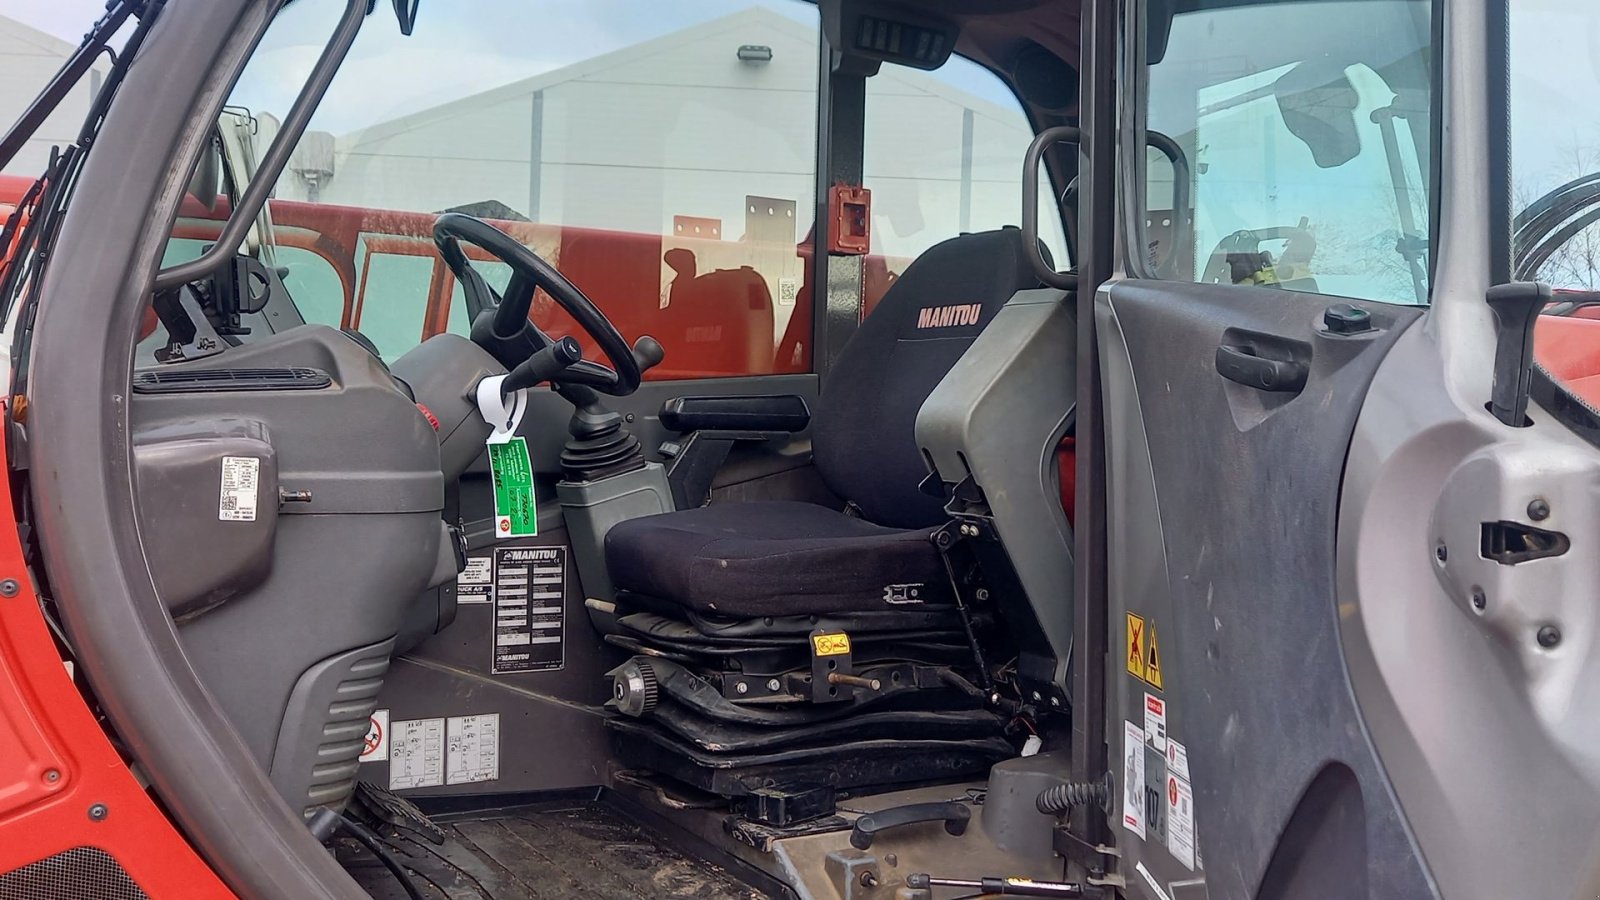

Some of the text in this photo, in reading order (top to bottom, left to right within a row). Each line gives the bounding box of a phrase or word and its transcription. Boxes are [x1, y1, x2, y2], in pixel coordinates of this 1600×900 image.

[917, 303, 982, 329] MANITOU
[512, 550, 557, 560] MANITOU
[501, 653, 530, 661] MANITOU
